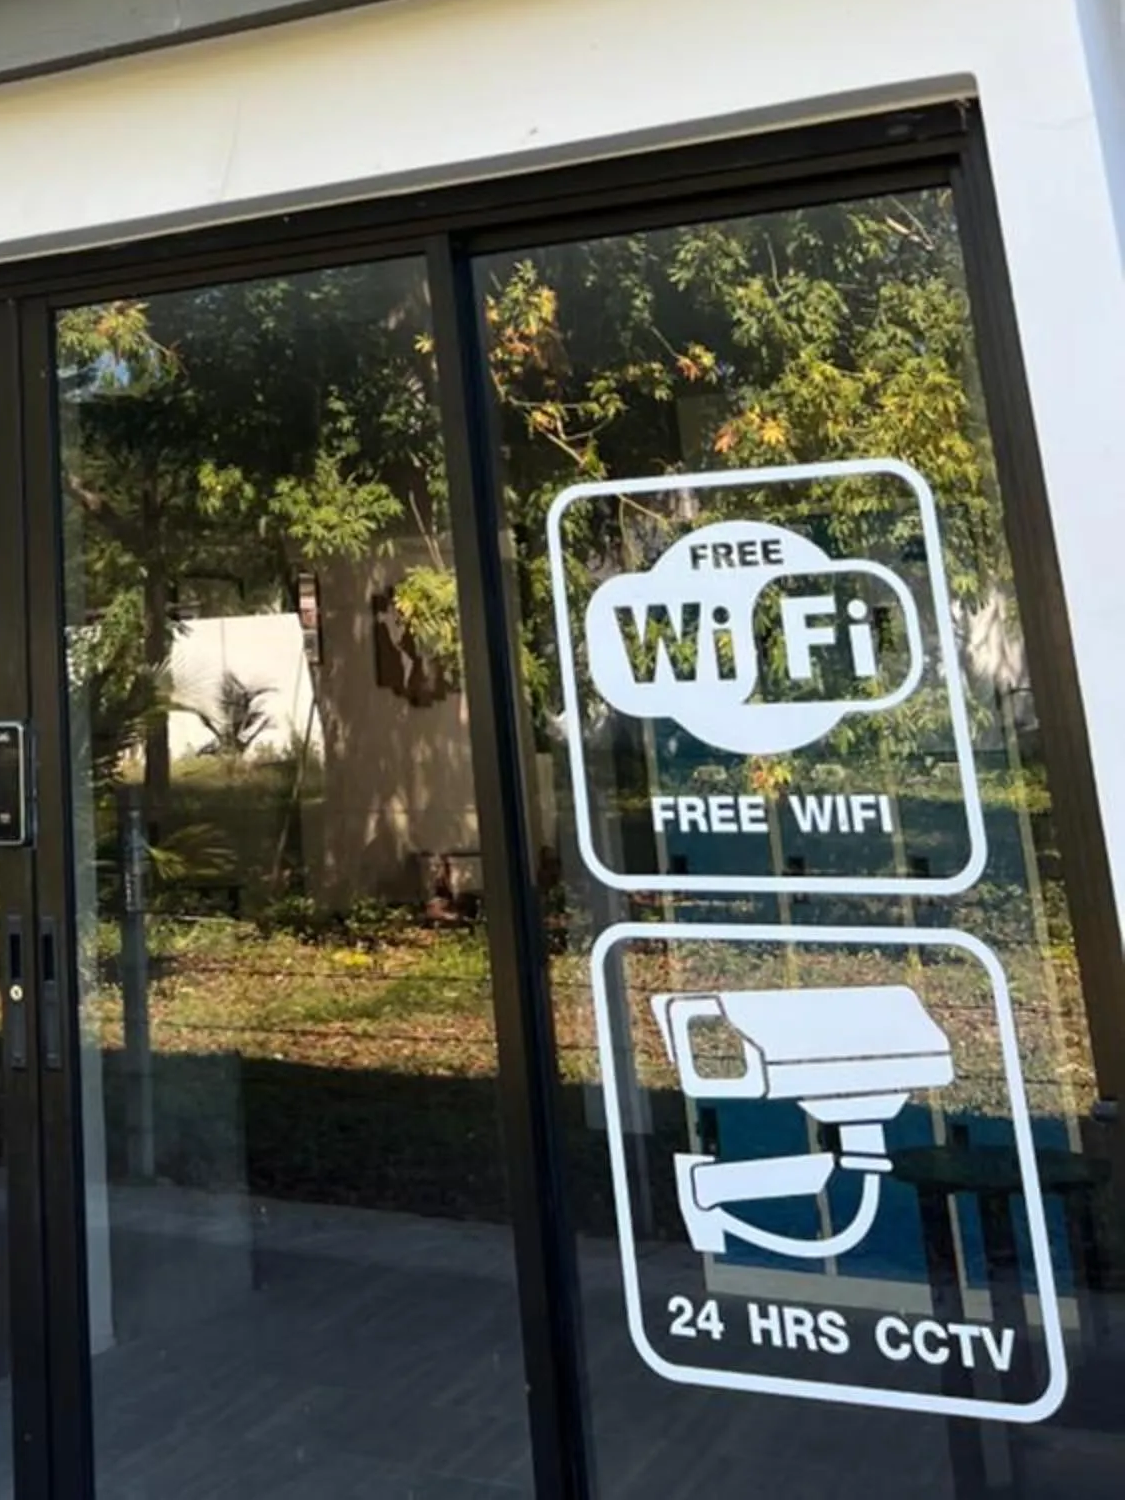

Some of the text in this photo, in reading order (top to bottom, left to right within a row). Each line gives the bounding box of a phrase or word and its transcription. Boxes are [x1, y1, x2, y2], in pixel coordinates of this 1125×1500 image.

[688, 538, 785, 571] FREE
[651, 794, 894, 834] FREE WIFI
[667, 1296, 1016, 1372] 24 HRS CCTV
